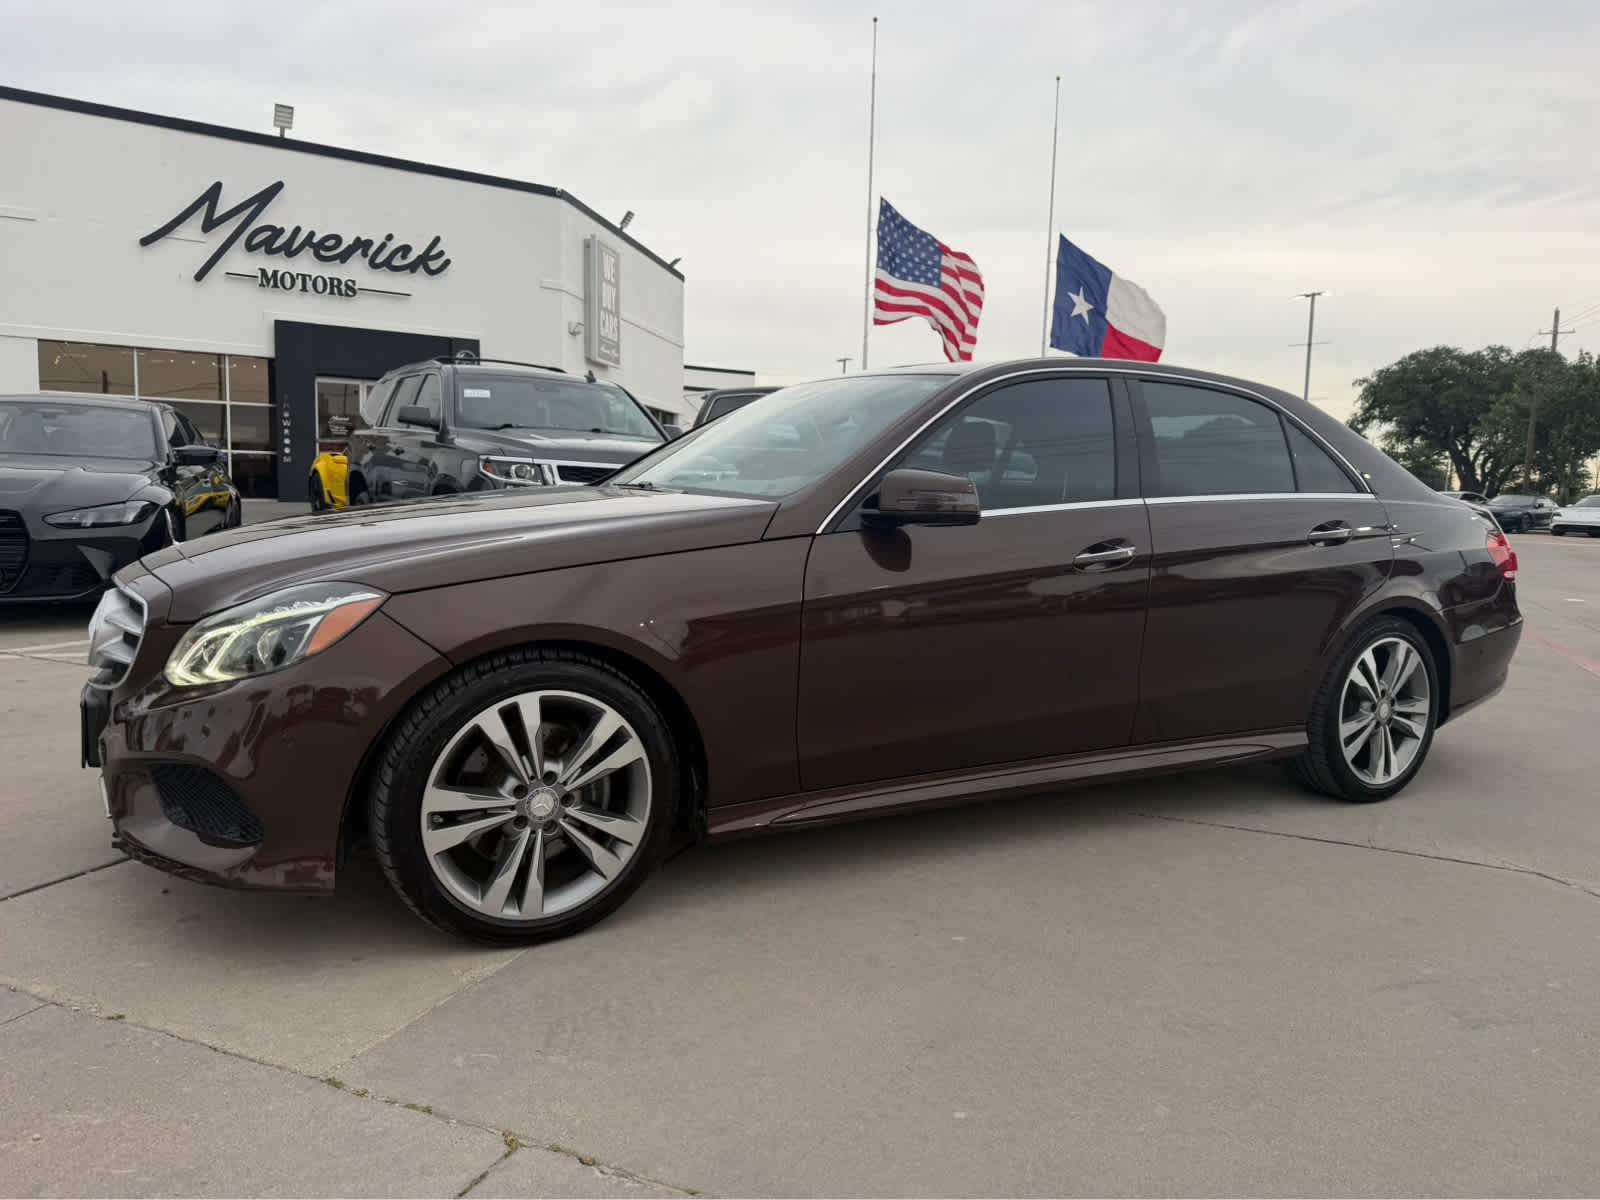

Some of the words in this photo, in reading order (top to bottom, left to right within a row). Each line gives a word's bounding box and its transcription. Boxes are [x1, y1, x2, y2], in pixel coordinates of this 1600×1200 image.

[139, 180, 451, 282] Maverick
[257, 267, 358, 298] MOTORS
[602, 251, 616, 283] WE
[601, 281, 617, 313] BUY
[600, 309, 619, 343] CARS
